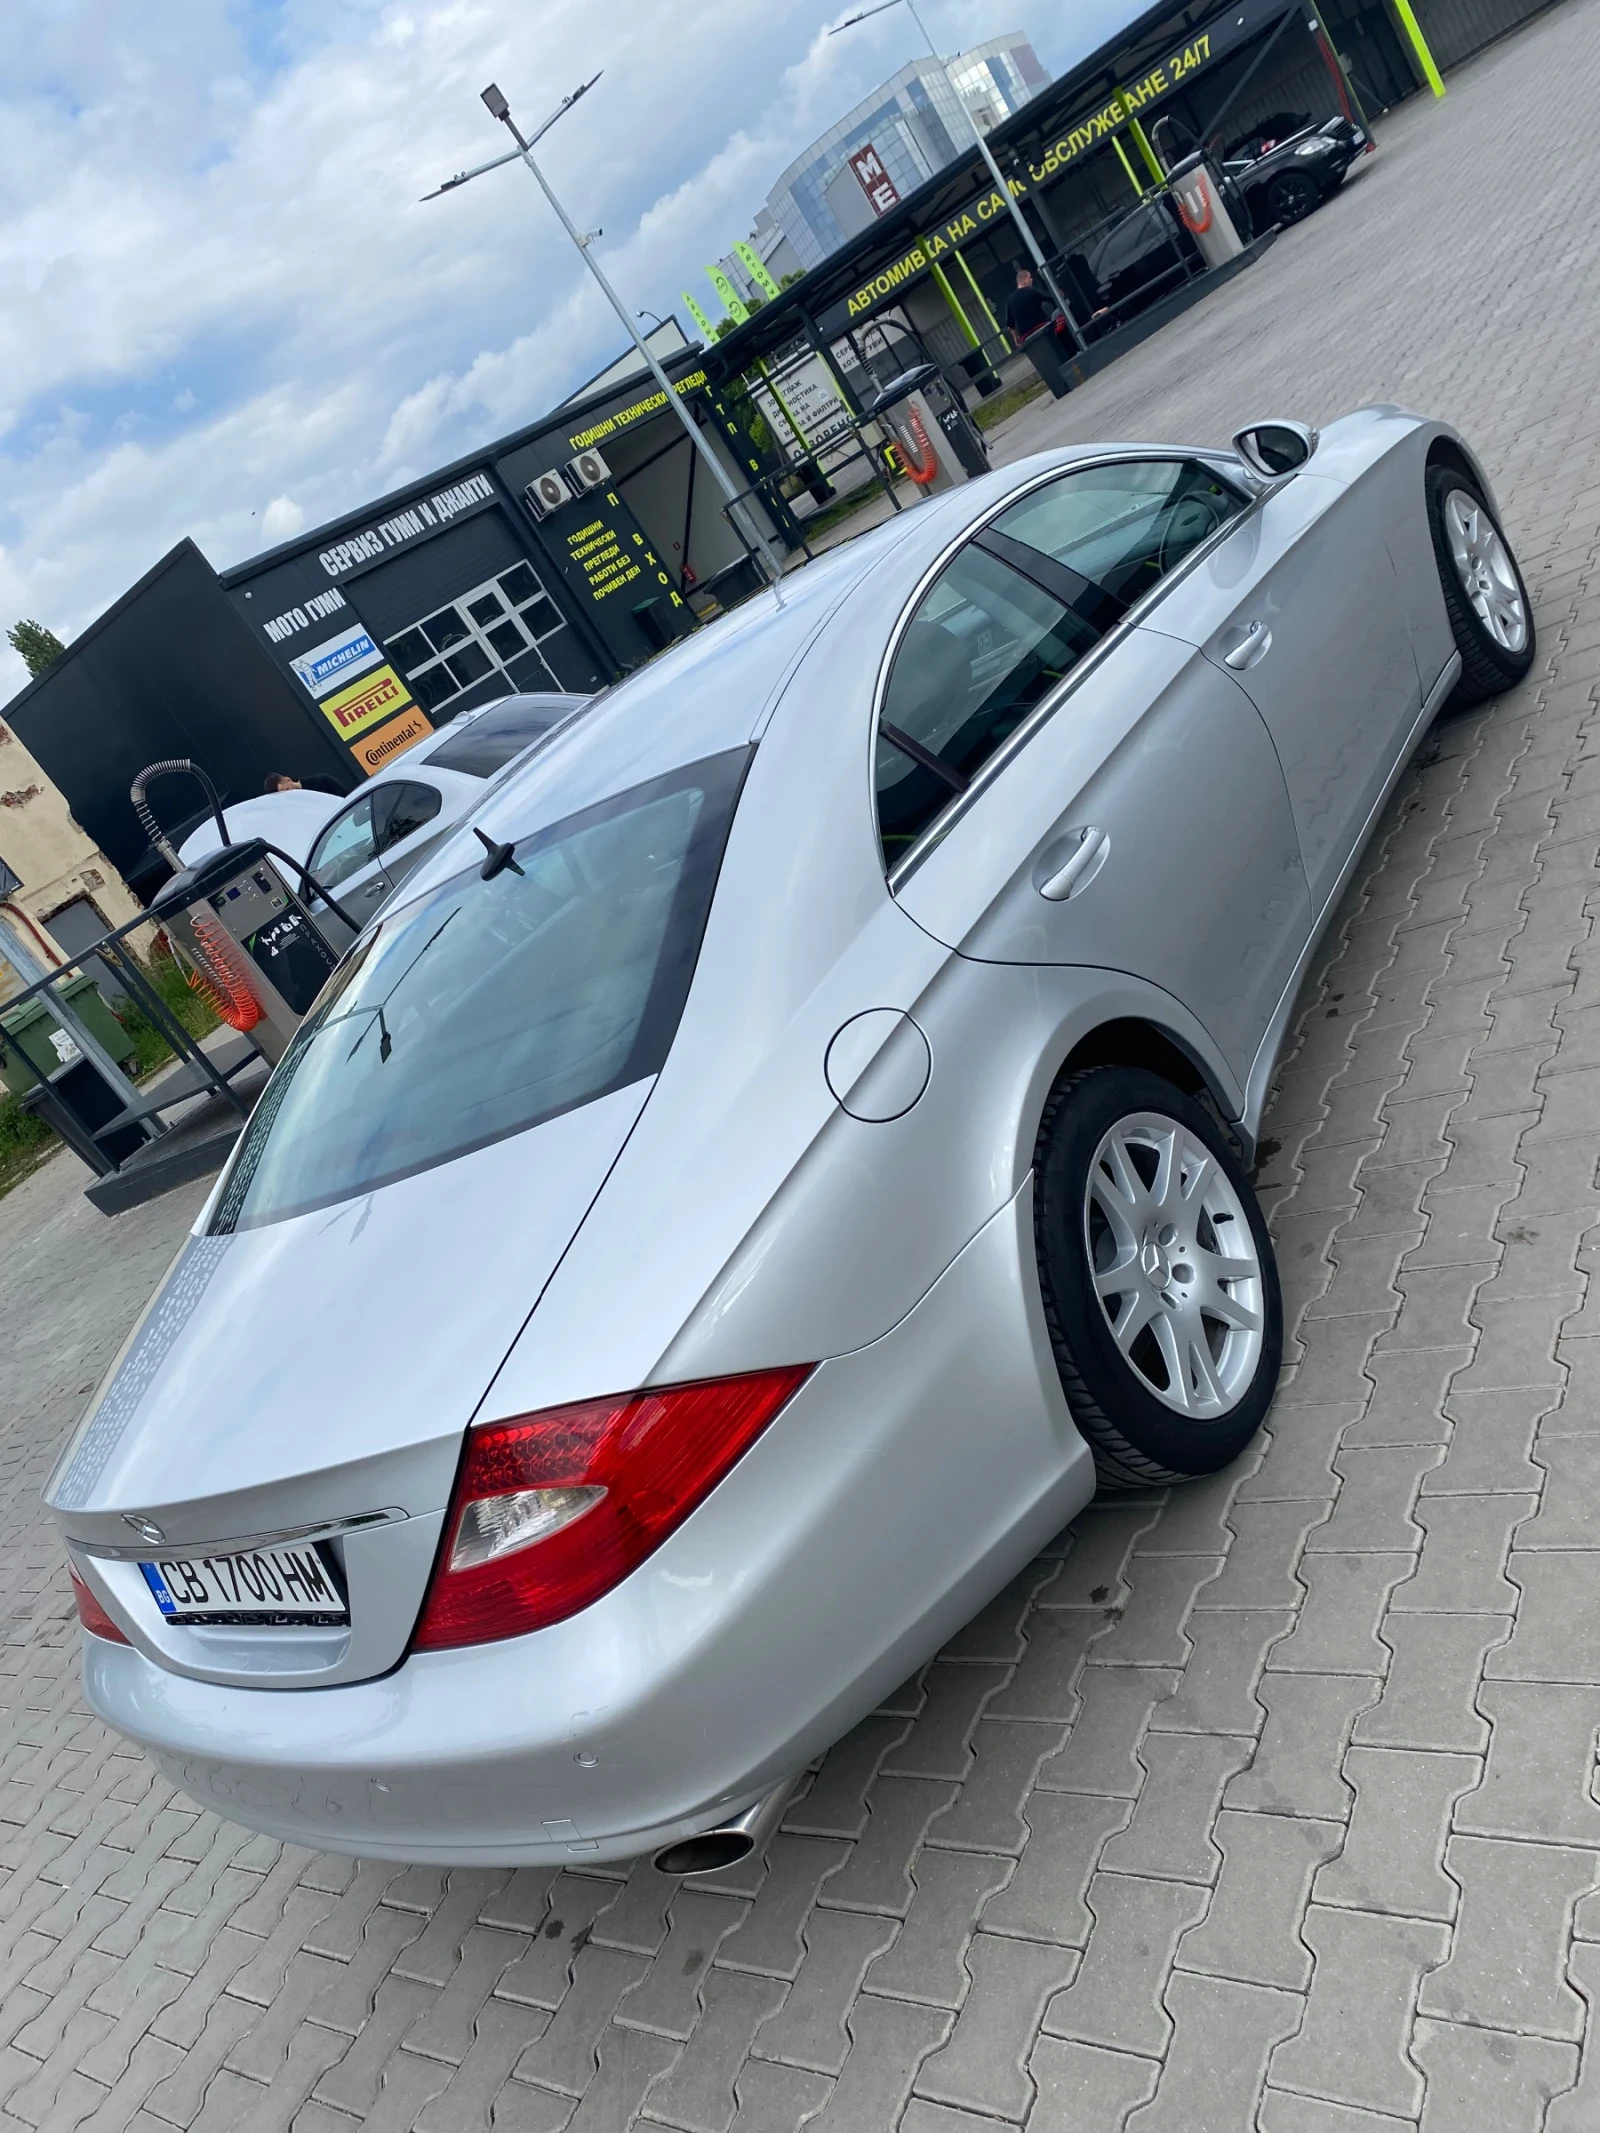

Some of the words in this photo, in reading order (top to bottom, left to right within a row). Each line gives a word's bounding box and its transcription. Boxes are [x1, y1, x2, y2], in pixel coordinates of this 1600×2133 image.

[847, 235, 948, 316] АВТОМИВКА
[947, 214, 977, 243] НА
[1169, 34, 1211, 80] 24/7
[569, 418, 616, 451] ГОДИШНИ
[613, 390, 669, 427] ТЕХНИЧЕСКИ
[671, 369, 708, 394] РЕГЛЕДИ
[811, 396, 839, 418] ФИЛТРИ
[318, 530, 384, 576] СЕРВИЗ
[378, 510, 425, 546] ГУМИ
[418, 502, 438, 526] И
[431, 474, 494, 523] ДЖАНТИ
[567, 520, 604, 545] ГОДИШНИ
[570, 530, 616, 561] ТЕХНИЧЕСКИ
[583, 544, 620, 571] ПРЕГЛЕДИ
[588, 561, 618, 585] РАБОТИ
[617, 554, 631, 570] БЕЗ
[593, 574, 627, 601] ПОЧИВЕН
[626, 565, 641, 582] ДЕН
[263, 608, 309, 643] МОТО
[304, 587, 346, 621] ГУМИ
[316, 639, 370, 676] MICHELIN
[333, 678, 399, 727] PIRELLI
[365, 723, 417, 766] Continental
[159, 1561, 208, 1604] CB
[203, 1553, 283, 1602] 1700
[271, 1551, 335, 1602] HM
[156, 1590, 171, 1604] BG
